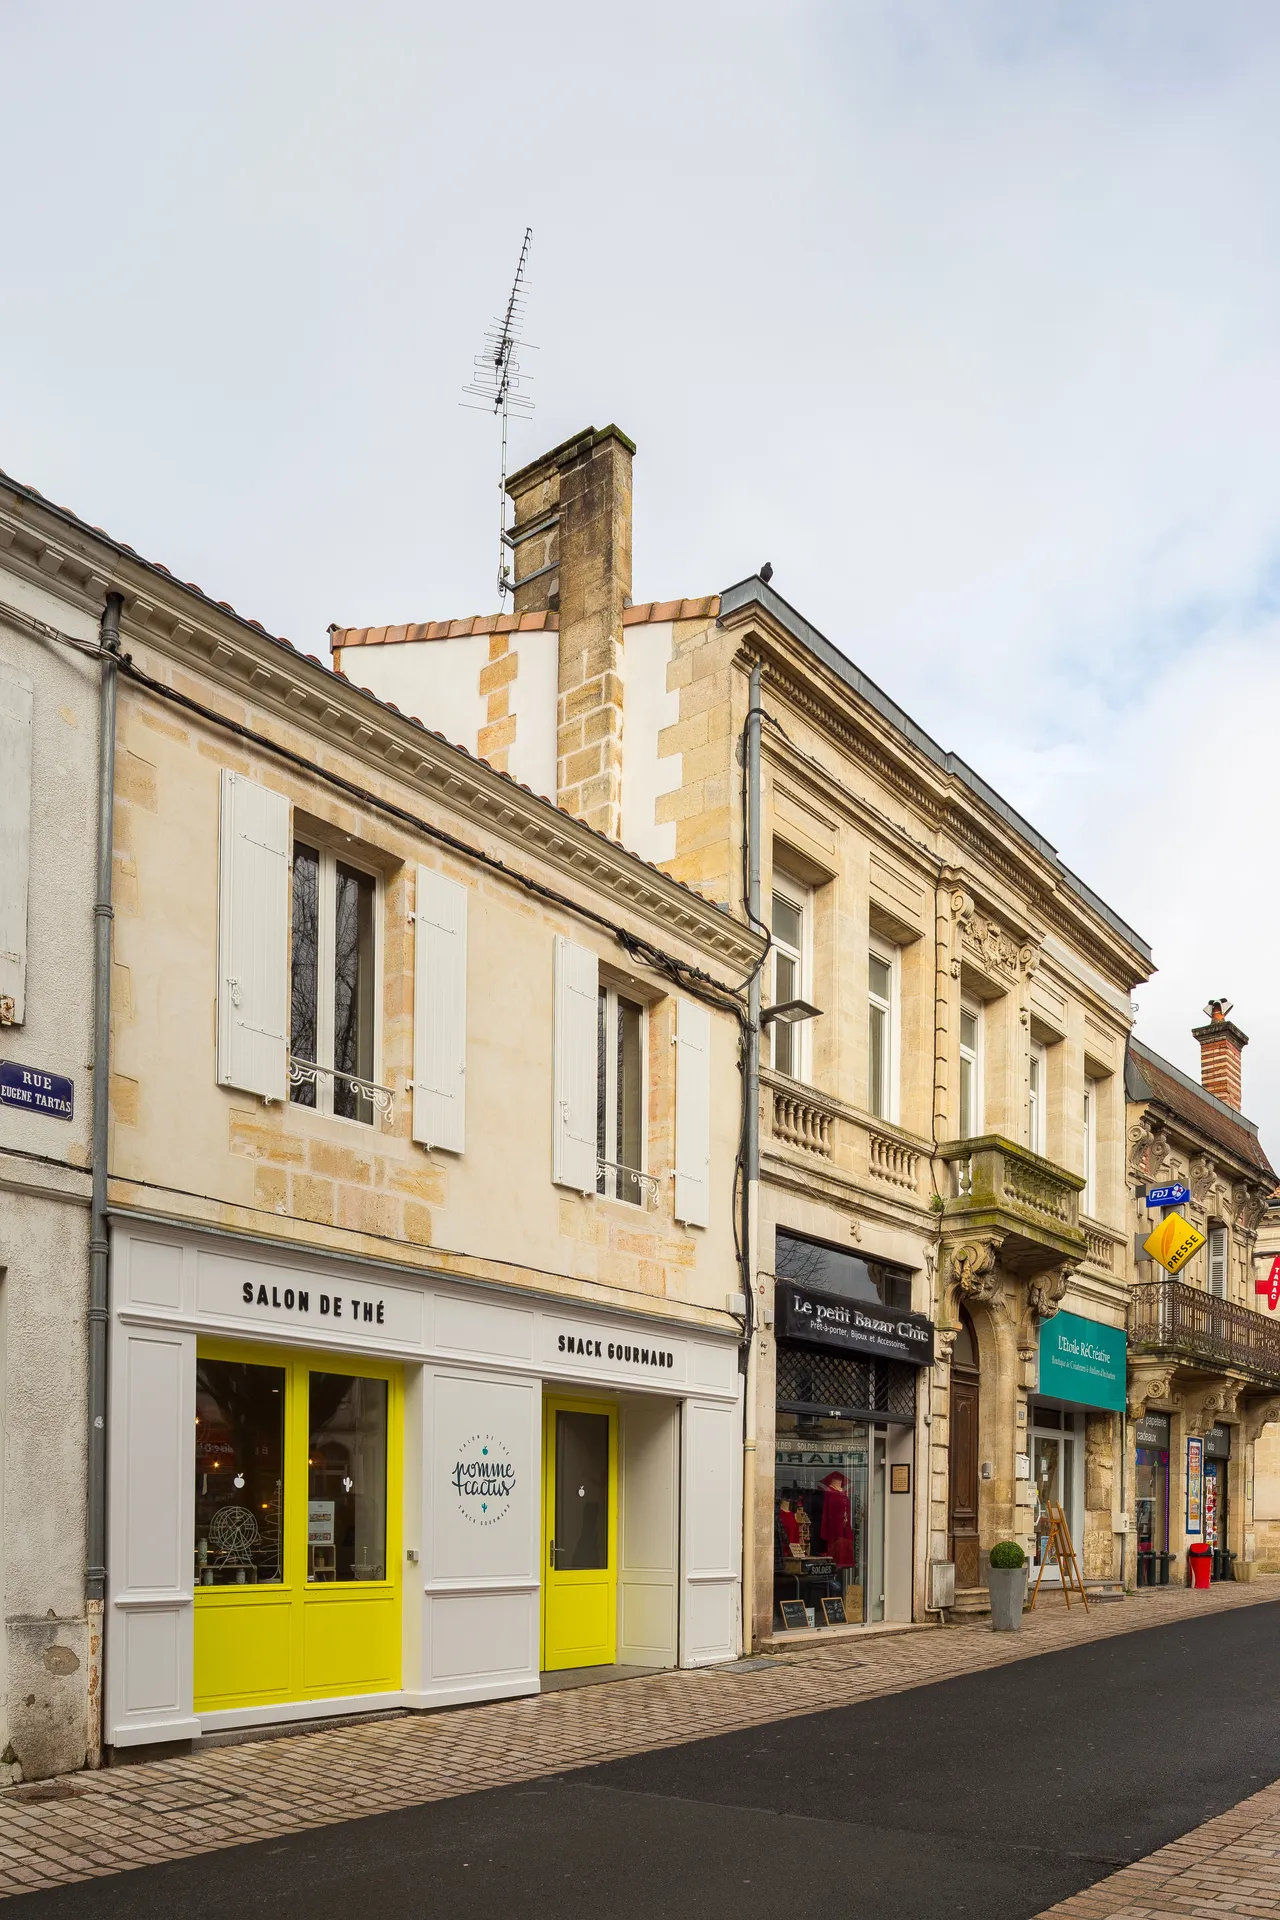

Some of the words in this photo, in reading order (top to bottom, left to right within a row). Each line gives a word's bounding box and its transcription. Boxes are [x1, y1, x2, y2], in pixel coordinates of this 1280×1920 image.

[22, 1071, 52, 1090] RUE
[35, 1093, 72, 1113] TARTAS
[1151, 1189, 1169, 1199] FDJ
[1167, 1235, 1199, 1269] PRESSE
[1270, 1267, 1280, 1300] TABAC
[242, 1282, 309, 1312] SALON
[319, 1294, 342, 1317] DE
[351, 1300, 385, 1324] THÉ
[793, 1294, 813, 1315] Le
[815, 1304, 851, 1323] petit
[853, 1310, 896, 1335] Bazar
[850, 1329, 868, 1341] Bijoux
[869, 1335, 876, 1343] et
[558, 1334, 602, 1358] SNACK
[607, 1342, 674, 1369] GOURMAND
[1145, 1416, 1167, 1428] papeterie
[1136, 1430, 1157, 1443] cadeaux
[797, 1442, 818, 1452] SOLDES
[823, 1444, 843, 1453] SOLDES
[452, 1461, 515, 1496] pomme
[454, 1479, 516, 1496] cactus
[811, 1565, 832, 1575] SOLDES
